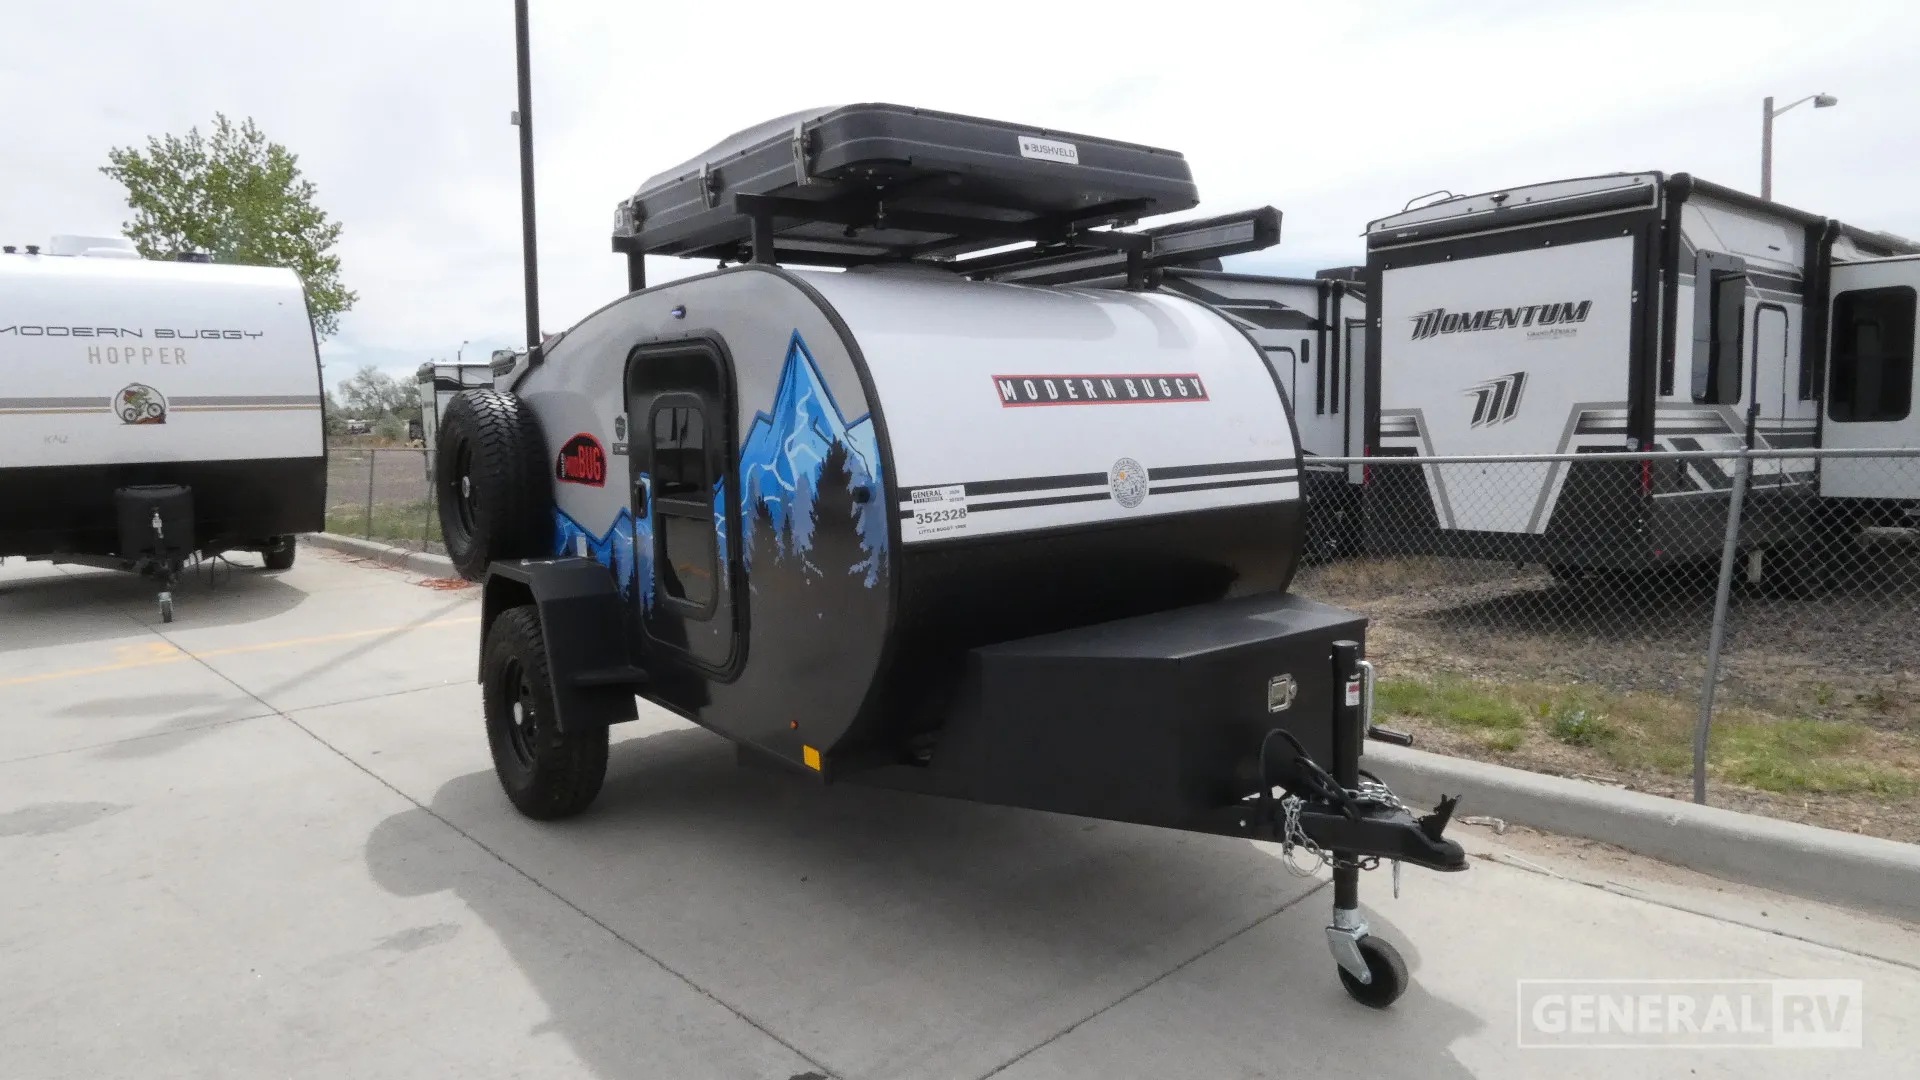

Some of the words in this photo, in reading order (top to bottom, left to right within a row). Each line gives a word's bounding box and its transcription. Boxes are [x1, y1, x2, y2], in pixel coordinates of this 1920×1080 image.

[1030, 143, 1075, 157] BUSHVELD
[1407, 300, 1592, 341] MOMENTUM
[154, 328, 264, 340] BUGGY
[87, 346, 188, 365] HOPPER
[998, 379, 1118, 401] MODERN
[1123, 377, 1204, 398] BUGGY
[912, 490, 942, 499] GENERAL
[915, 508, 967, 525] 352328
